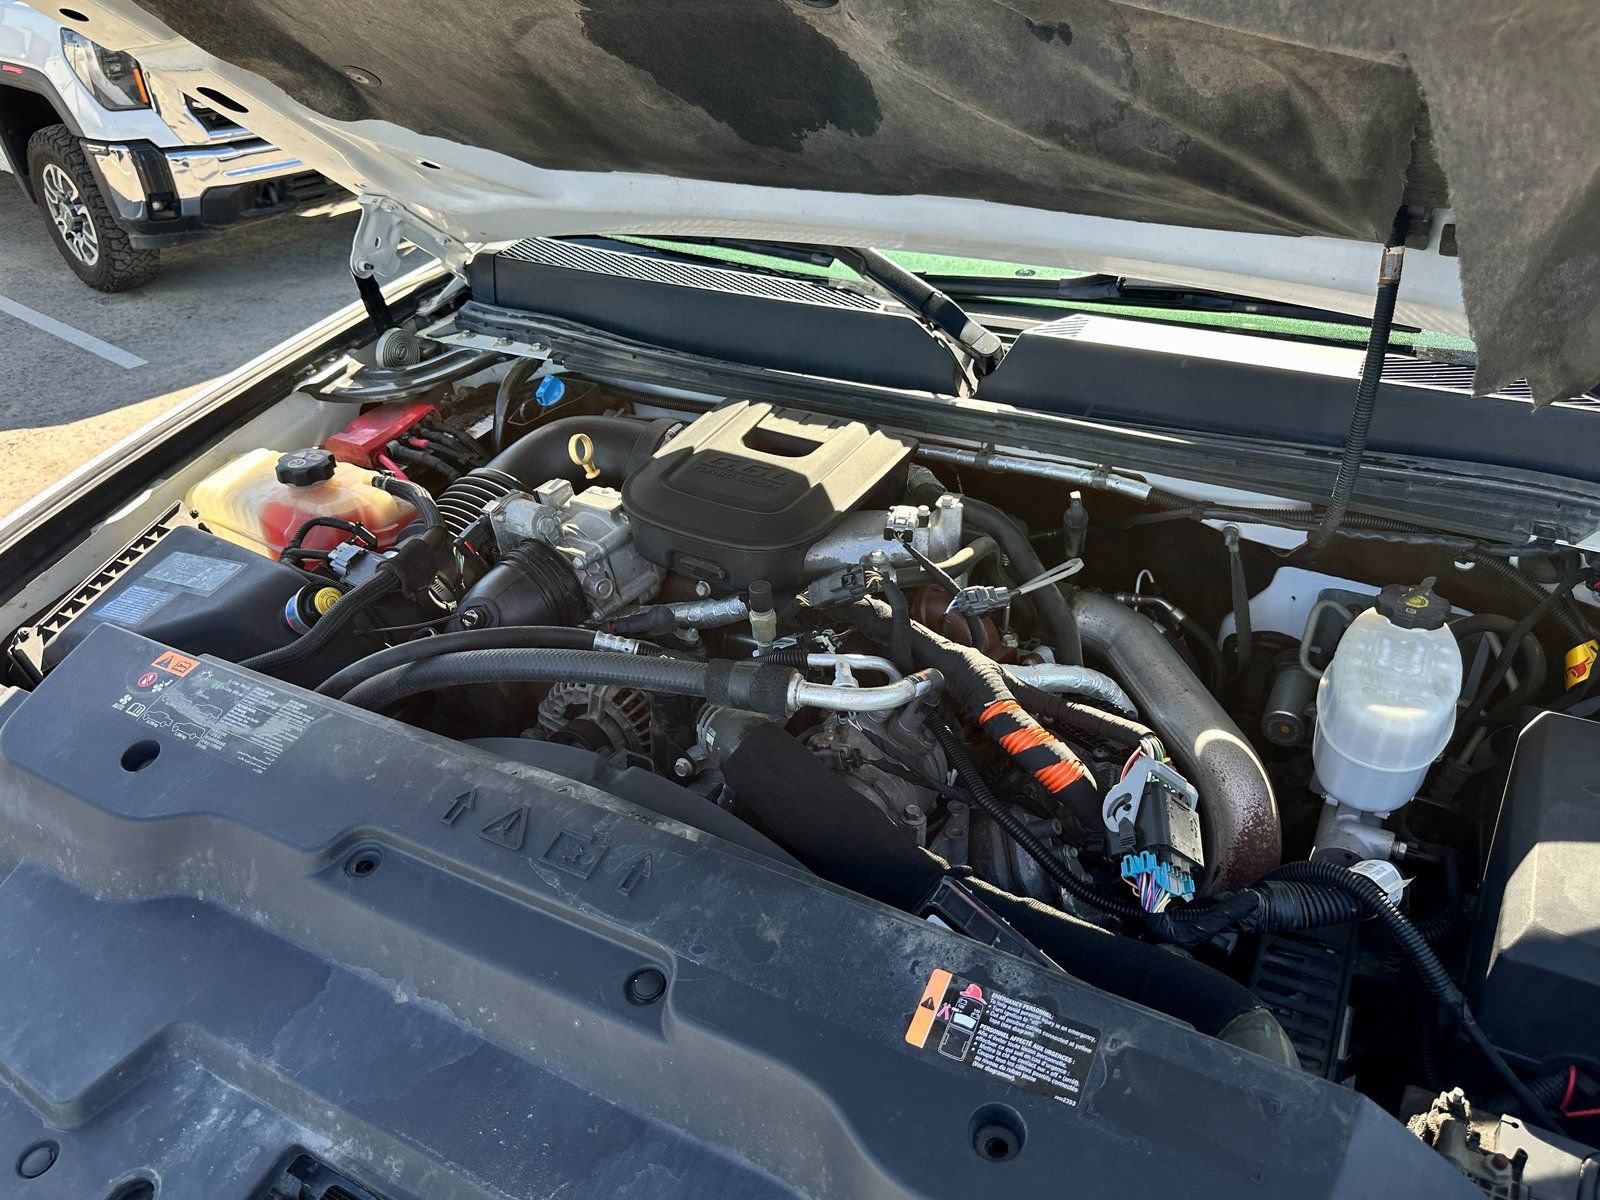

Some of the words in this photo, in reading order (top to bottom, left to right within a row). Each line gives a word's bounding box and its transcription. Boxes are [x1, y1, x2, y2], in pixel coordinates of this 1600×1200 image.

[991, 992, 1022, 1007] EMERGENCY
[1022, 1003, 1054, 1019] PERSONNEL:
[979, 1023, 1009, 1038] PERSONNEL
[1032, 1043, 1044, 1051] AUX
[1043, 1048, 1072, 1063] URGENCES
[1041, 1030, 1068, 1044] connected
[1074, 1042, 1092, 1054] yellow
